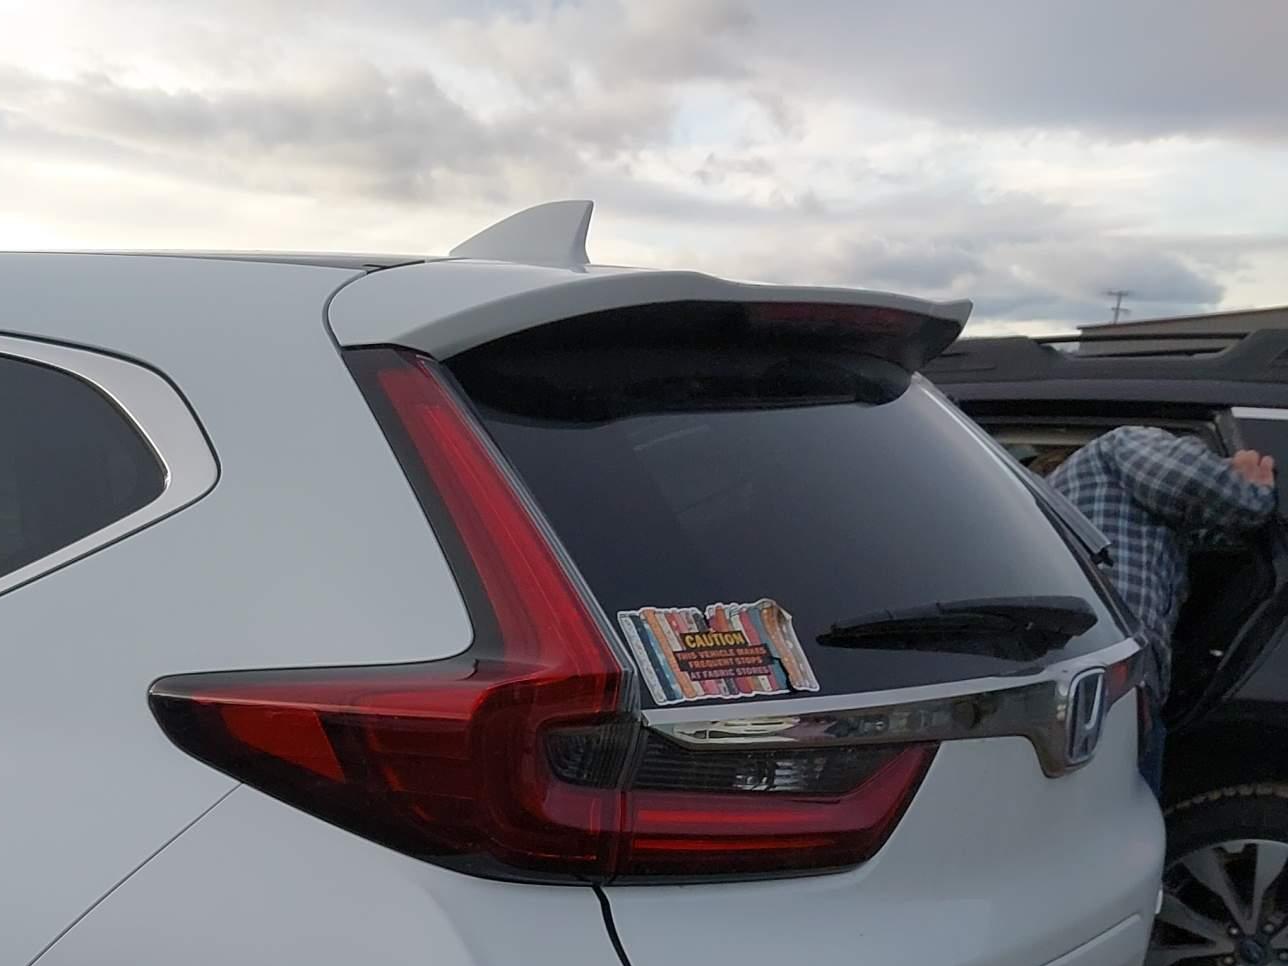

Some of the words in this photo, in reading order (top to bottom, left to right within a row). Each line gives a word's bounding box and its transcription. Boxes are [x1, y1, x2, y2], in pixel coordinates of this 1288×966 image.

[684, 632, 746, 649] CAUTION
[676, 651, 698, 661] THIS
[699, 648, 735, 659] VEHICLE
[736, 645, 767, 656] MAKES
[688, 657, 735, 668] FREQUENT
[735, 655, 763, 665] STOPS
[690, 671, 702, 680] AT
[702, 668, 735, 678] FABRIC
[736, 665, 769, 676] STORES
